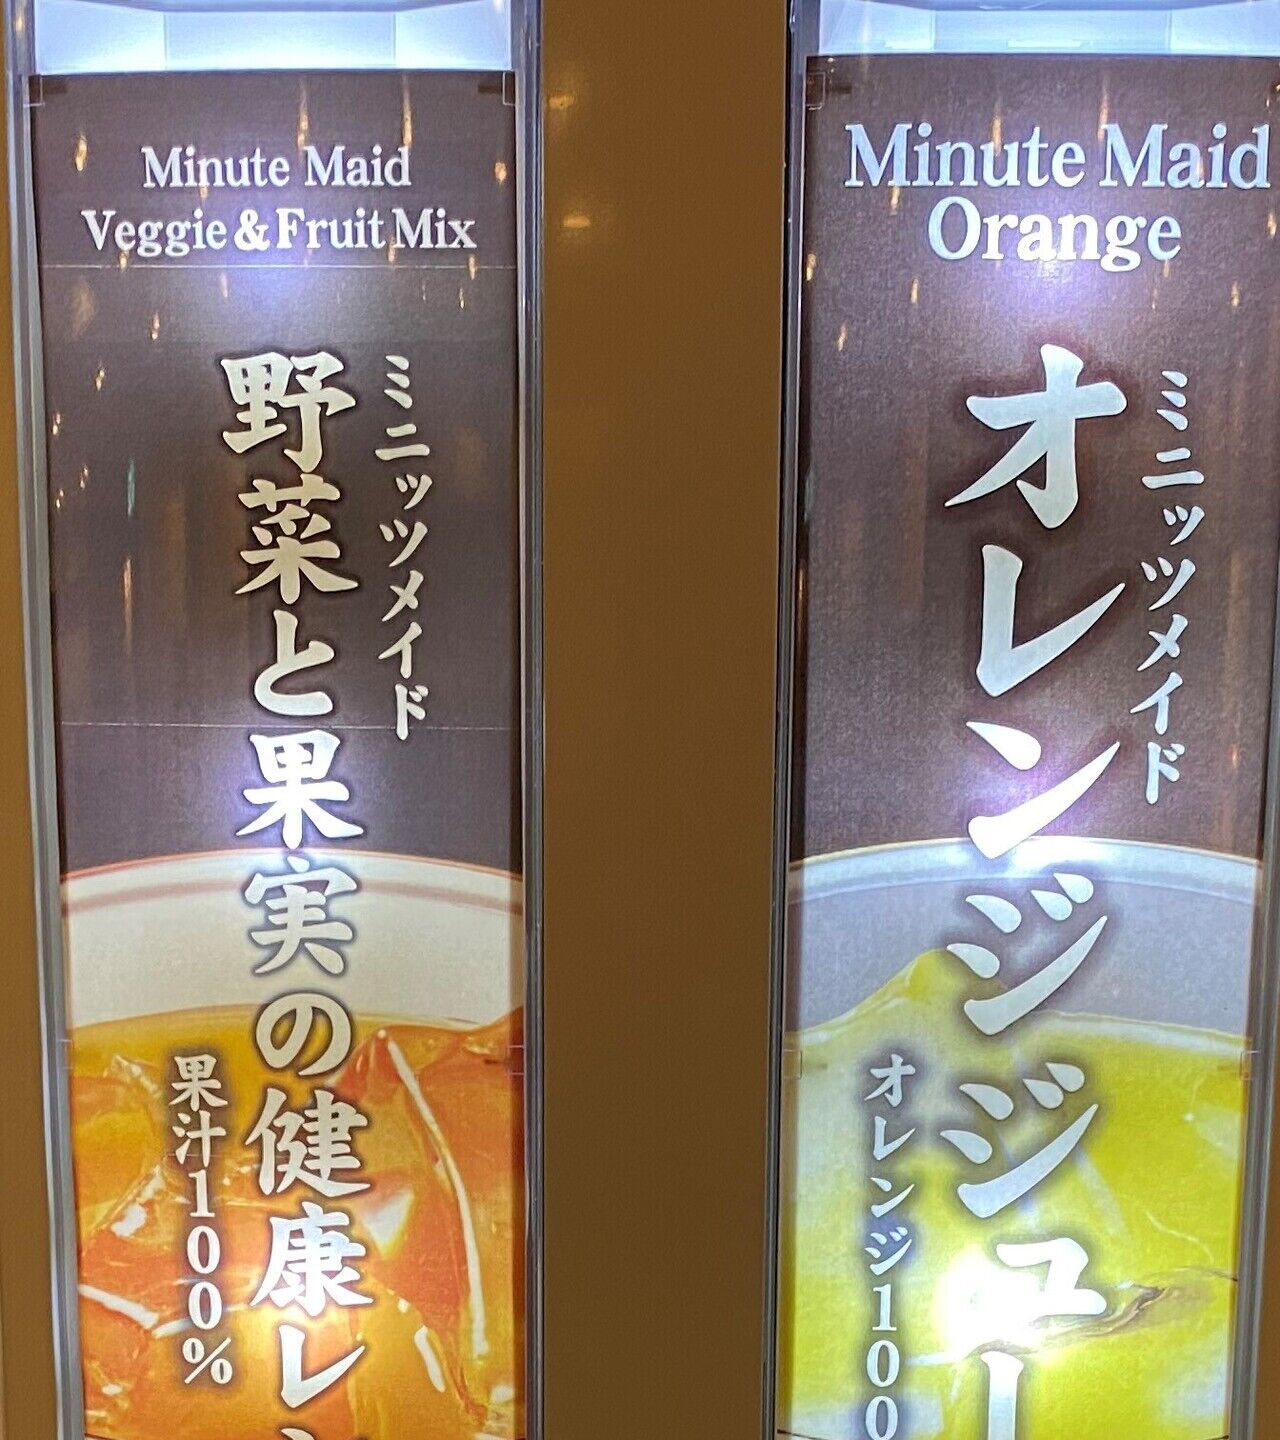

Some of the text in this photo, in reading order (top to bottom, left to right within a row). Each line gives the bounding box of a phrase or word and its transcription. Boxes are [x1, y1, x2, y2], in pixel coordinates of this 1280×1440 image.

[141, 145, 412, 188] Minute Maid
[845, 122, 1271, 189] Minute Maid
[81, 207, 477, 258] Veggie & Fruit Mix
[928, 196, 1181, 272] Orange
[375, 354, 430, 740] ミニッツメイド
[1130, 370, 1205, 804] ミニッツメイド
[169, 1054, 233, 1386] 果汁100%
